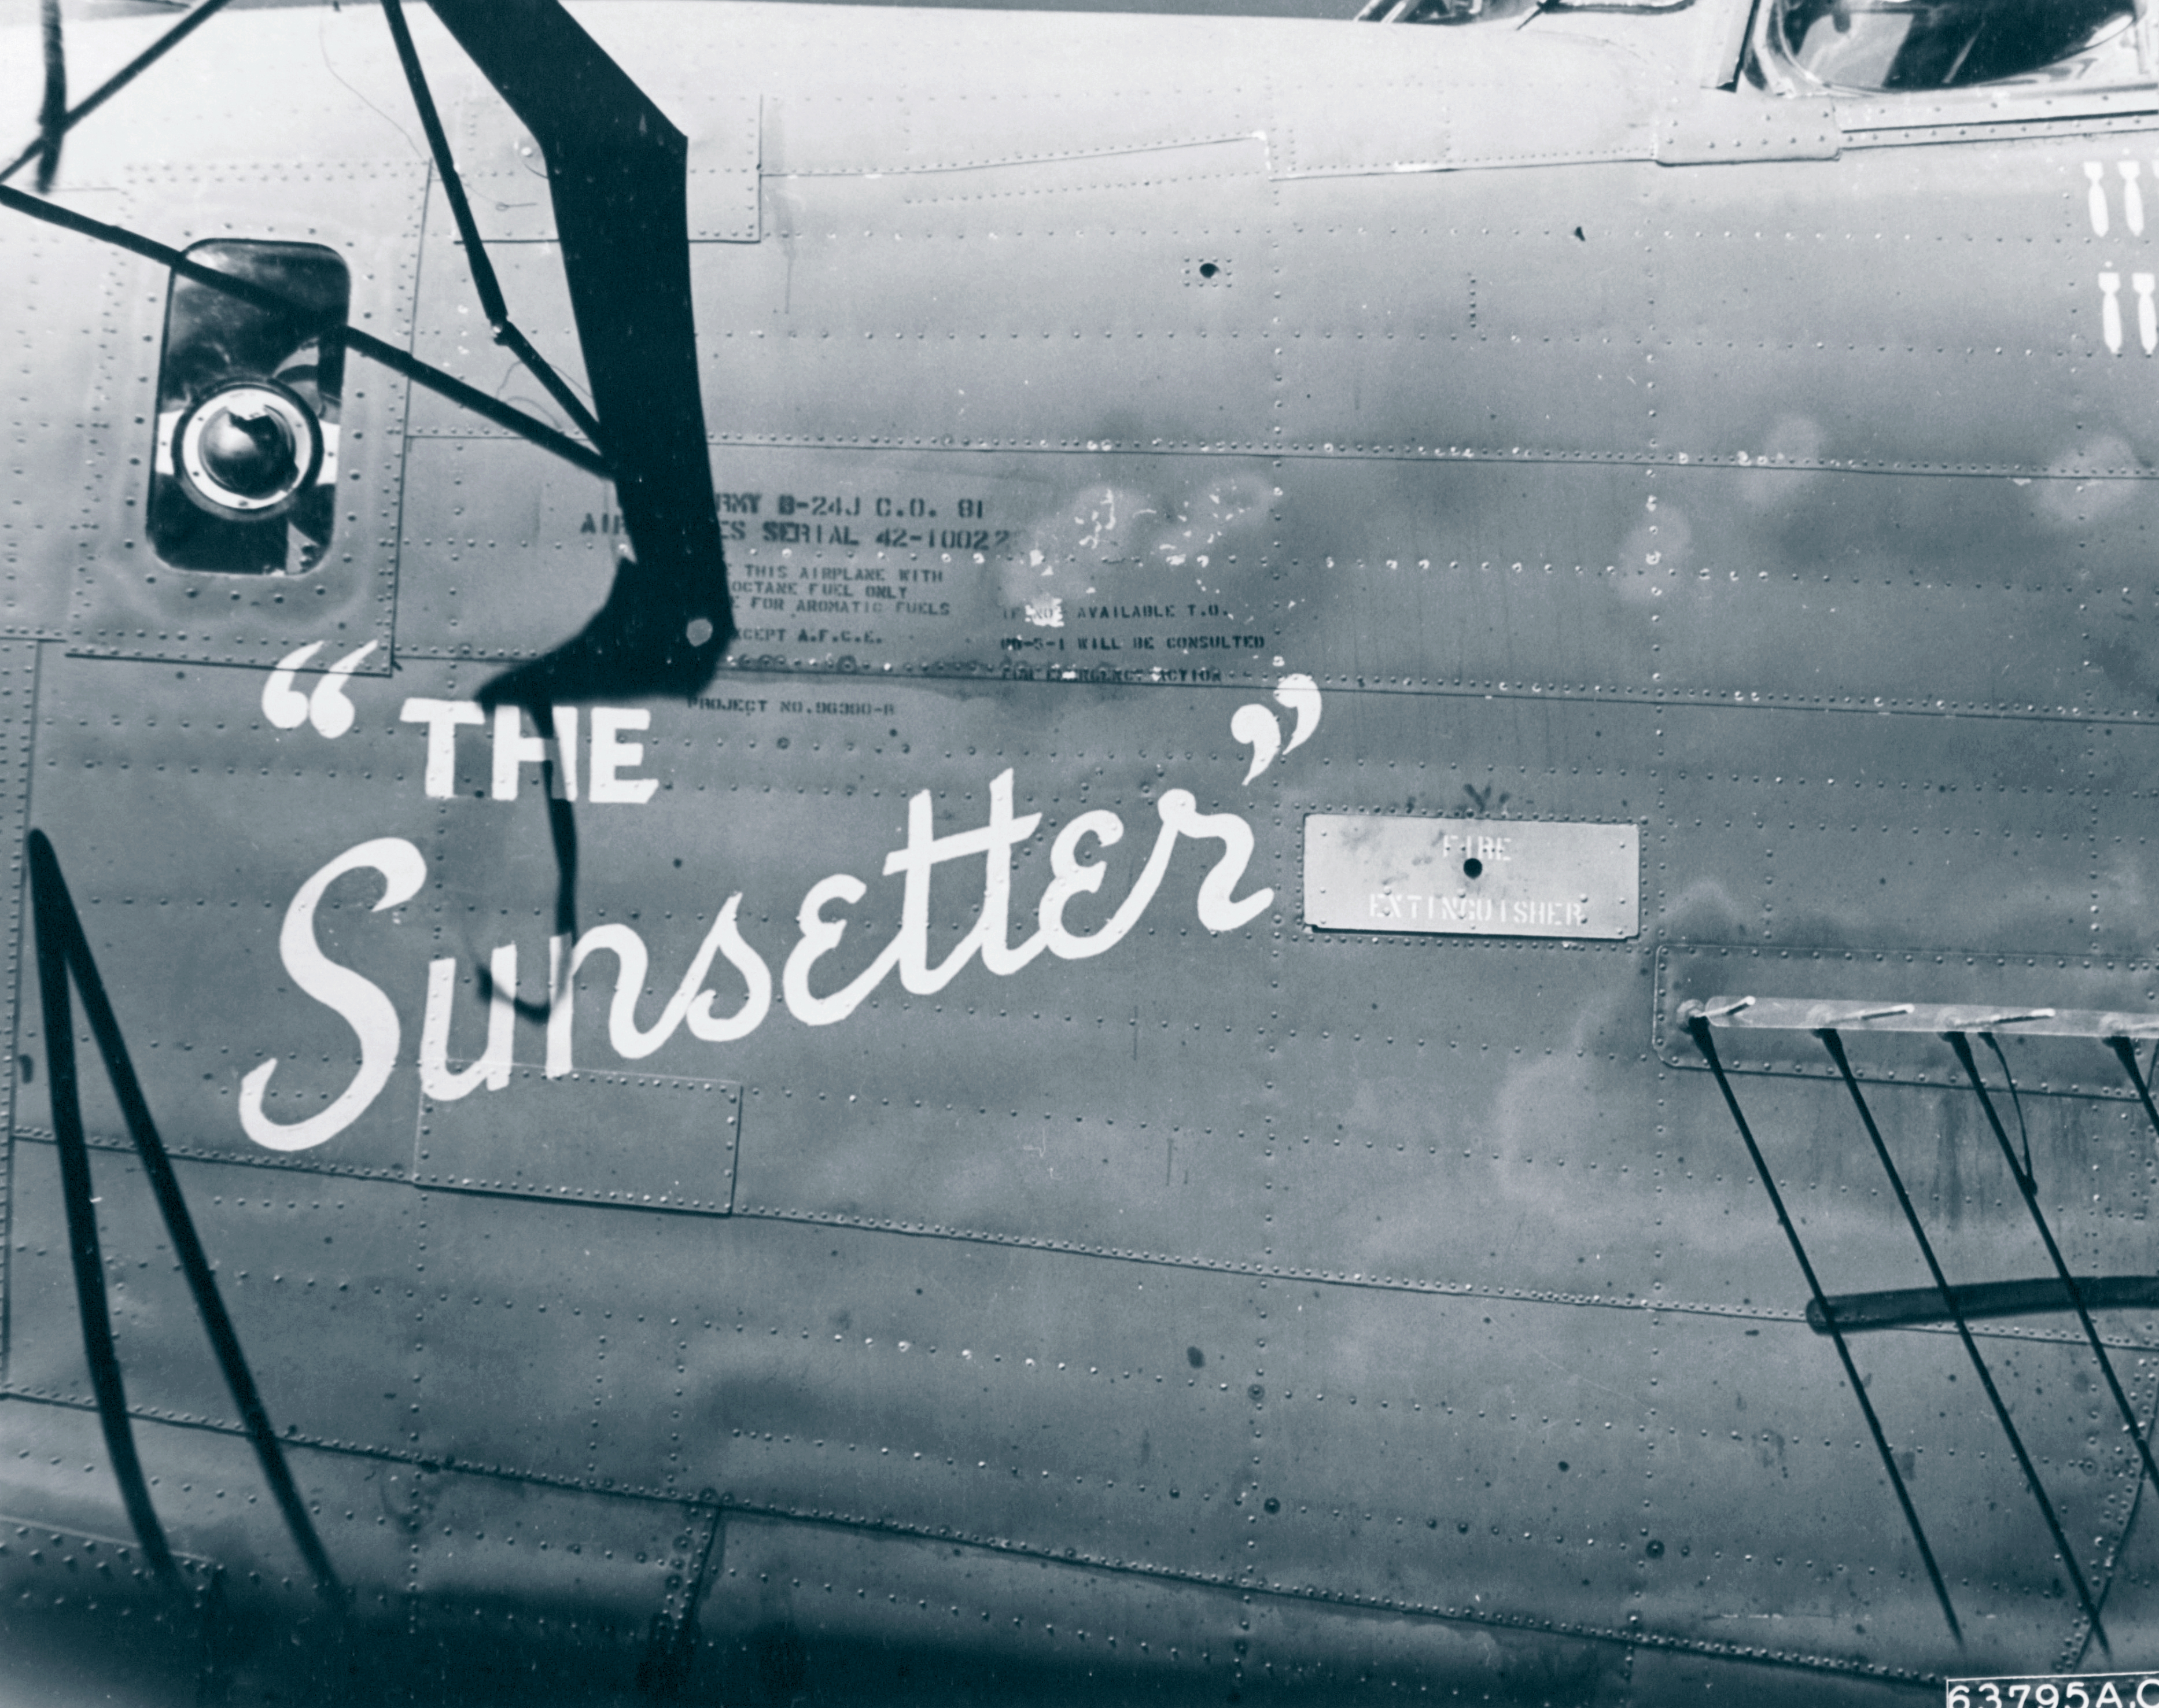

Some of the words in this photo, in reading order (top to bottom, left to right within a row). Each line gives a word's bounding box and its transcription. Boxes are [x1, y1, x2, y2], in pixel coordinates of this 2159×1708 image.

[715, 493, 762, 514] RMY
[957, 498, 983, 519] 81
[762, 521, 860, 547] SERIAL
[745, 563, 787, 578] THIS
[800, 566, 885, 581] AIRPLANE
[898, 568, 943, 583] WITH
[731, 580, 798, 596] OCTANE
[809, 582, 853, 597] FUEL
[865, 585, 907, 600] ONLY
[751, 595, 784, 611] FOR
[795, 599, 882, 614] AROMATIC
[896, 601, 950, 616] FUELS
[1078, 604, 1176, 619] AVAILABLE
[1187, 603, 1228, 618] T.O.
[1077, 637, 1121, 651] WILL
[1132, 636, 1155, 650] BE
[1166, 634, 1265, 650] CONSULTED
[1443, 835, 1511, 861] FIRE
[1369, 894, 1583, 927] EXTINGUISHER
